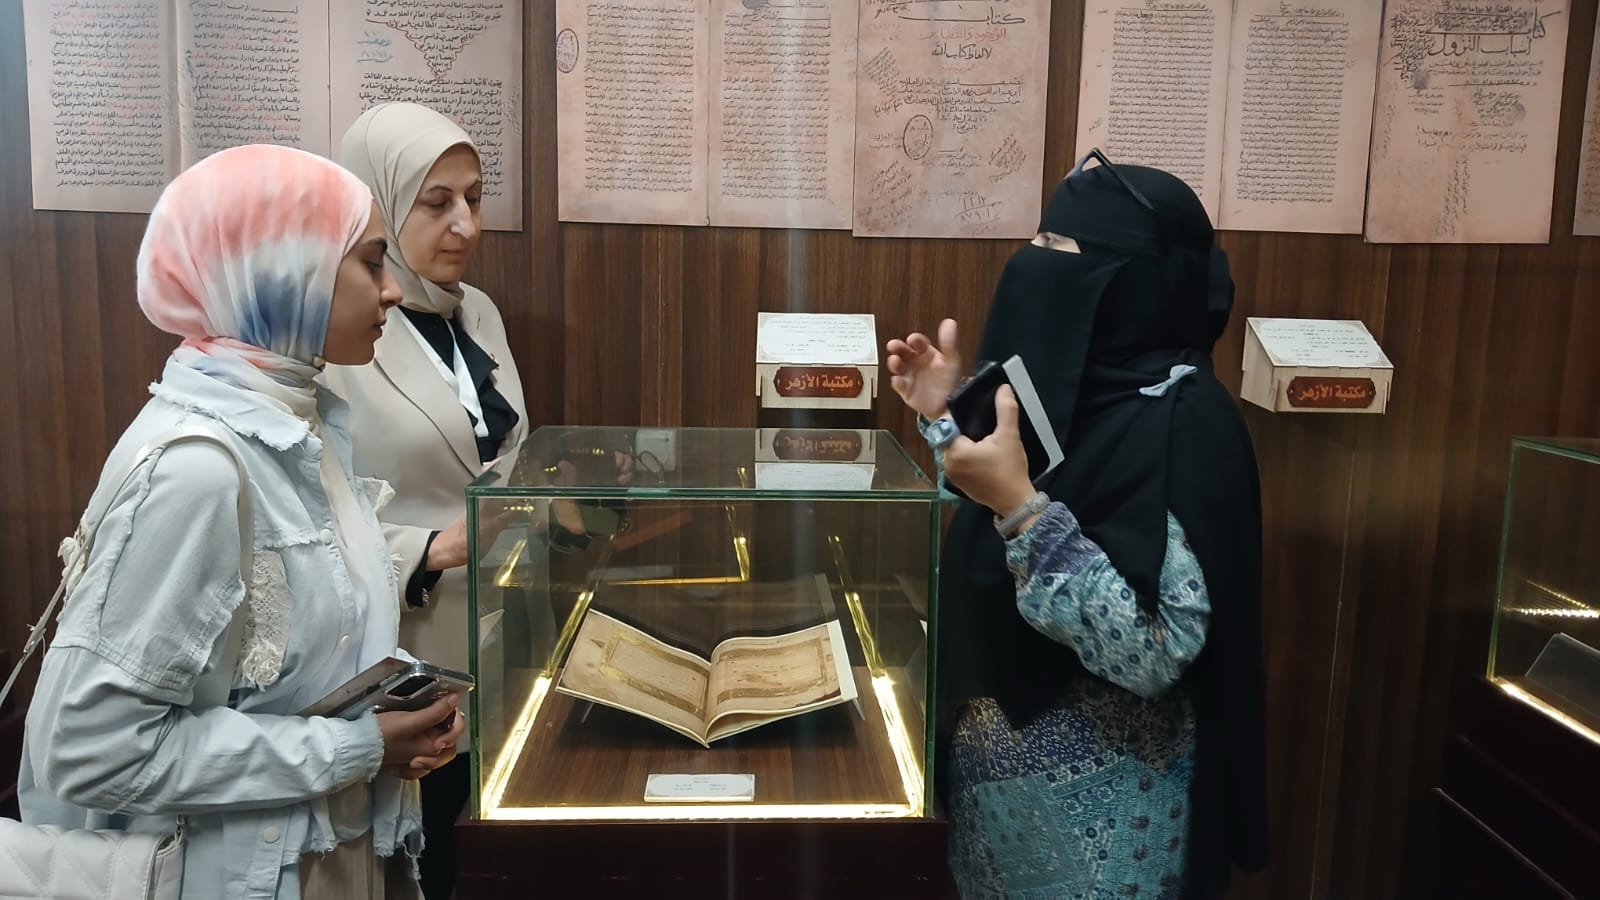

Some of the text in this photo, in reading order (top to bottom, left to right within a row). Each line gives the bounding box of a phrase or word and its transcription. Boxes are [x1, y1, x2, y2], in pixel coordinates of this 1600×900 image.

[897, 6, 1025, 26] كتاب
[1426, 7, 1561, 39] كتاب
[784, 373, 854, 392] مكتبة الأزهر
[1298, 384, 1367, 402] مكتبة الأزهر
